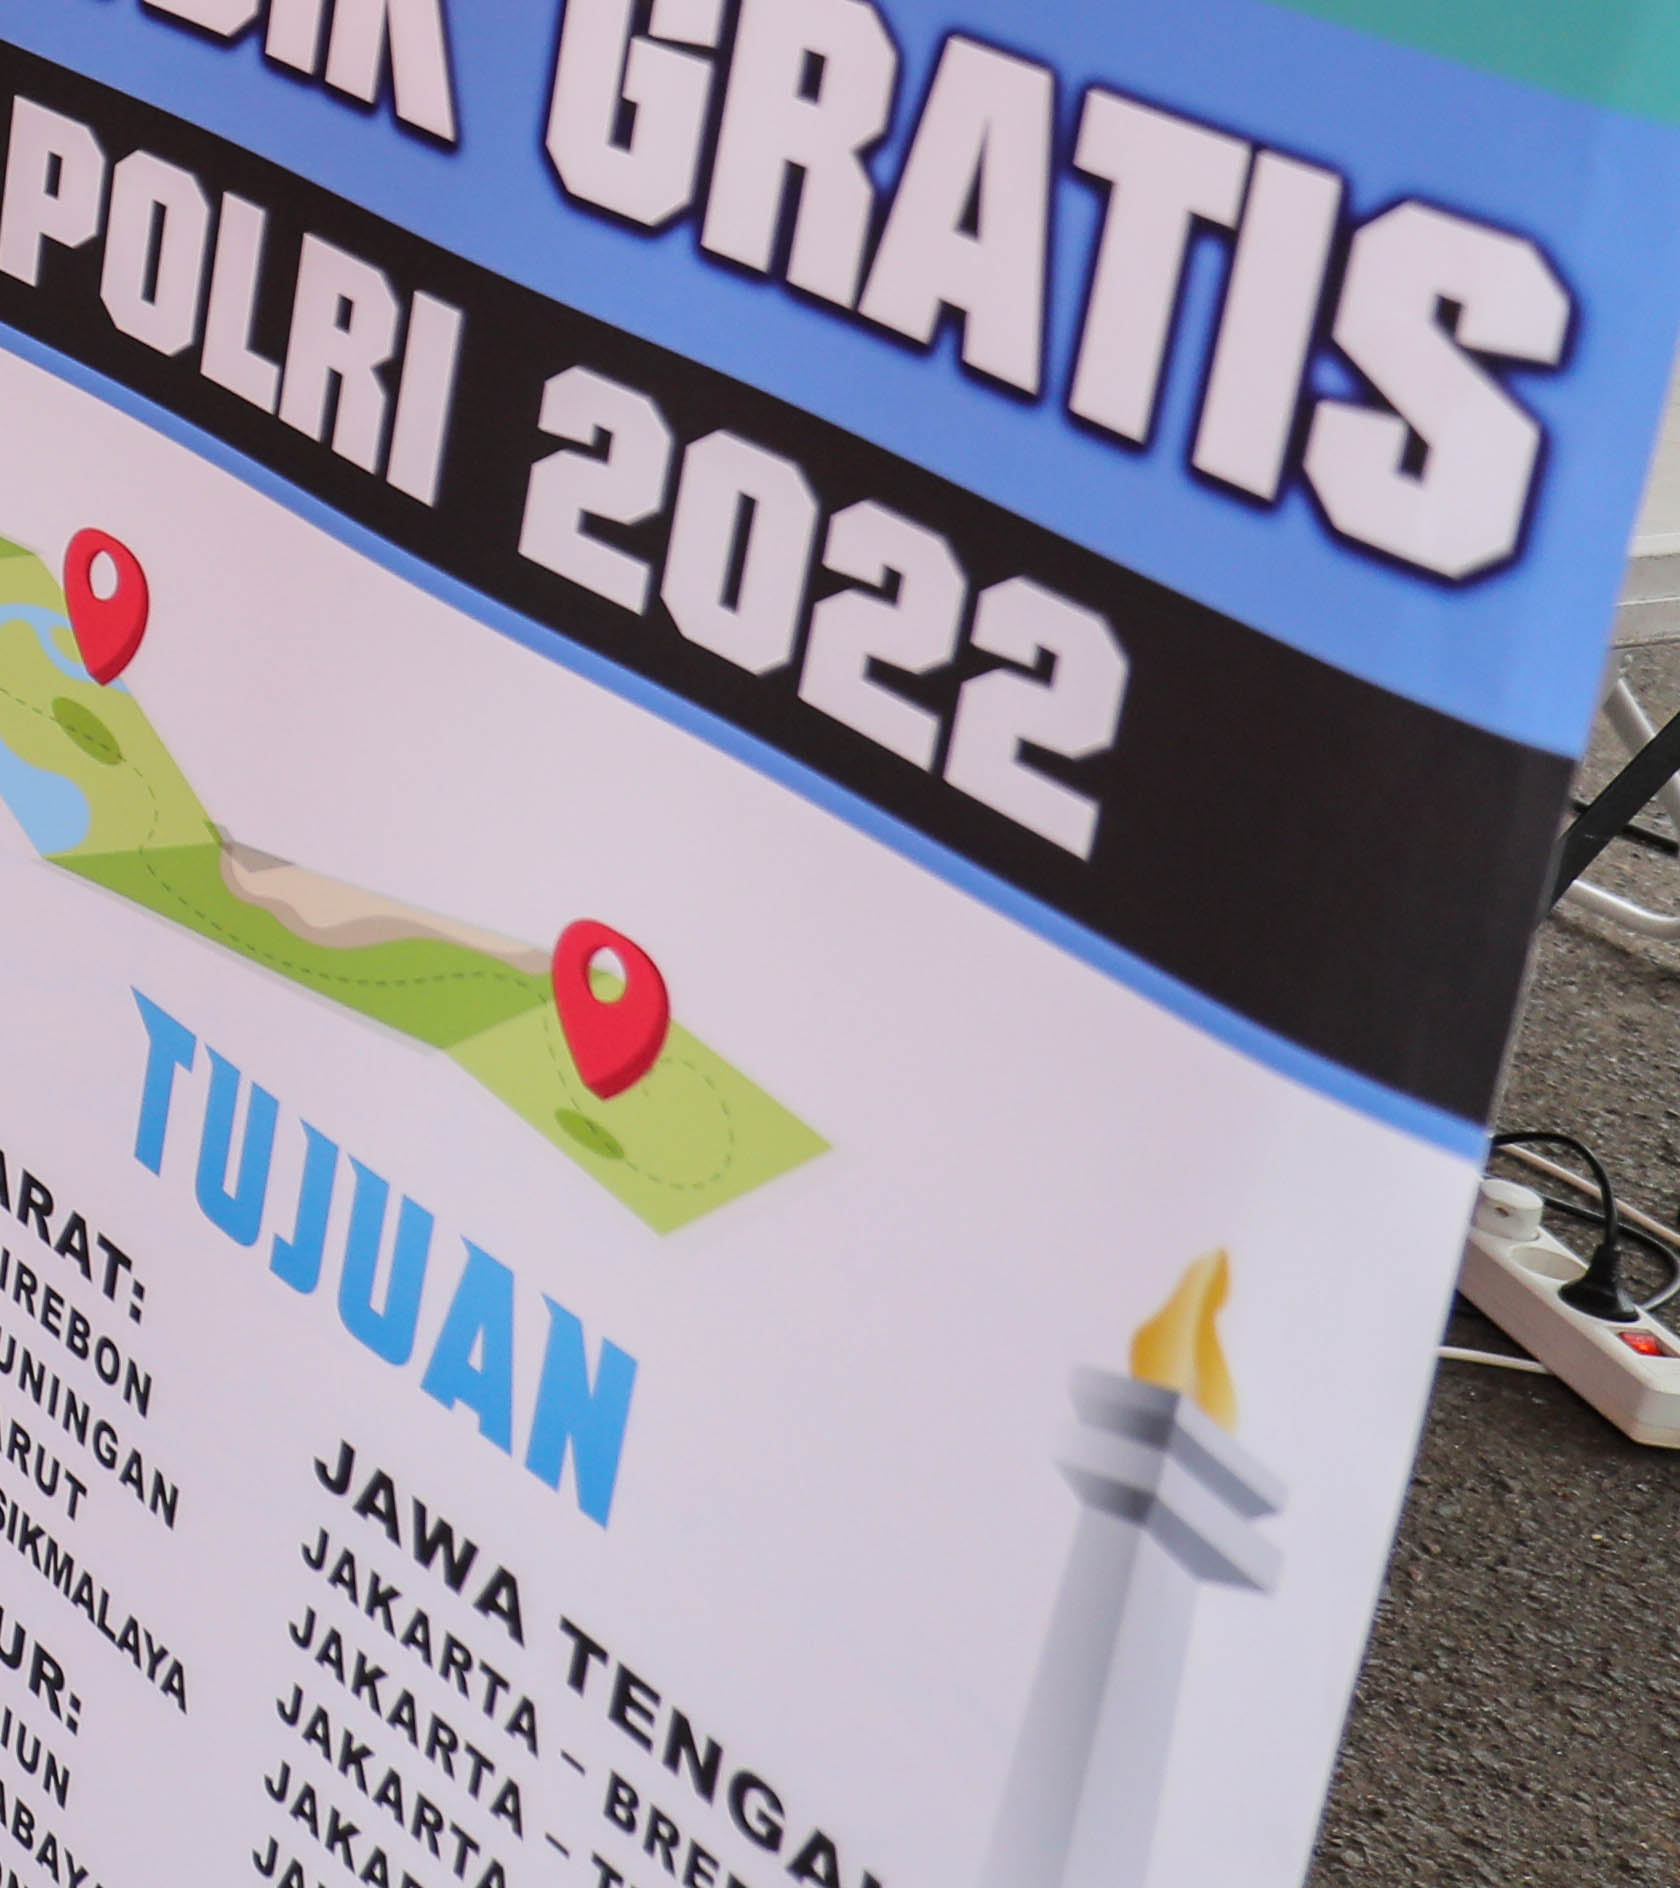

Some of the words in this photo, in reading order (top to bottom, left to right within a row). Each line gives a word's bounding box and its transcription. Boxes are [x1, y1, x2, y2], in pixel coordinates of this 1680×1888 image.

[516, 365, 1127, 859] 2022
[130, 983, 640, 1530] TUJUAN
[264, 1762, 423, 1888] JAKA
[289, 1607, 523, 1838] JAKARTA
[302, 1529, 538, 1756] JAKARTA
[604, 1772, 747, 1888] BRE
[315, 1441, 524, 1646] JAWA
[560, 1617, 882, 1888] TENGA
